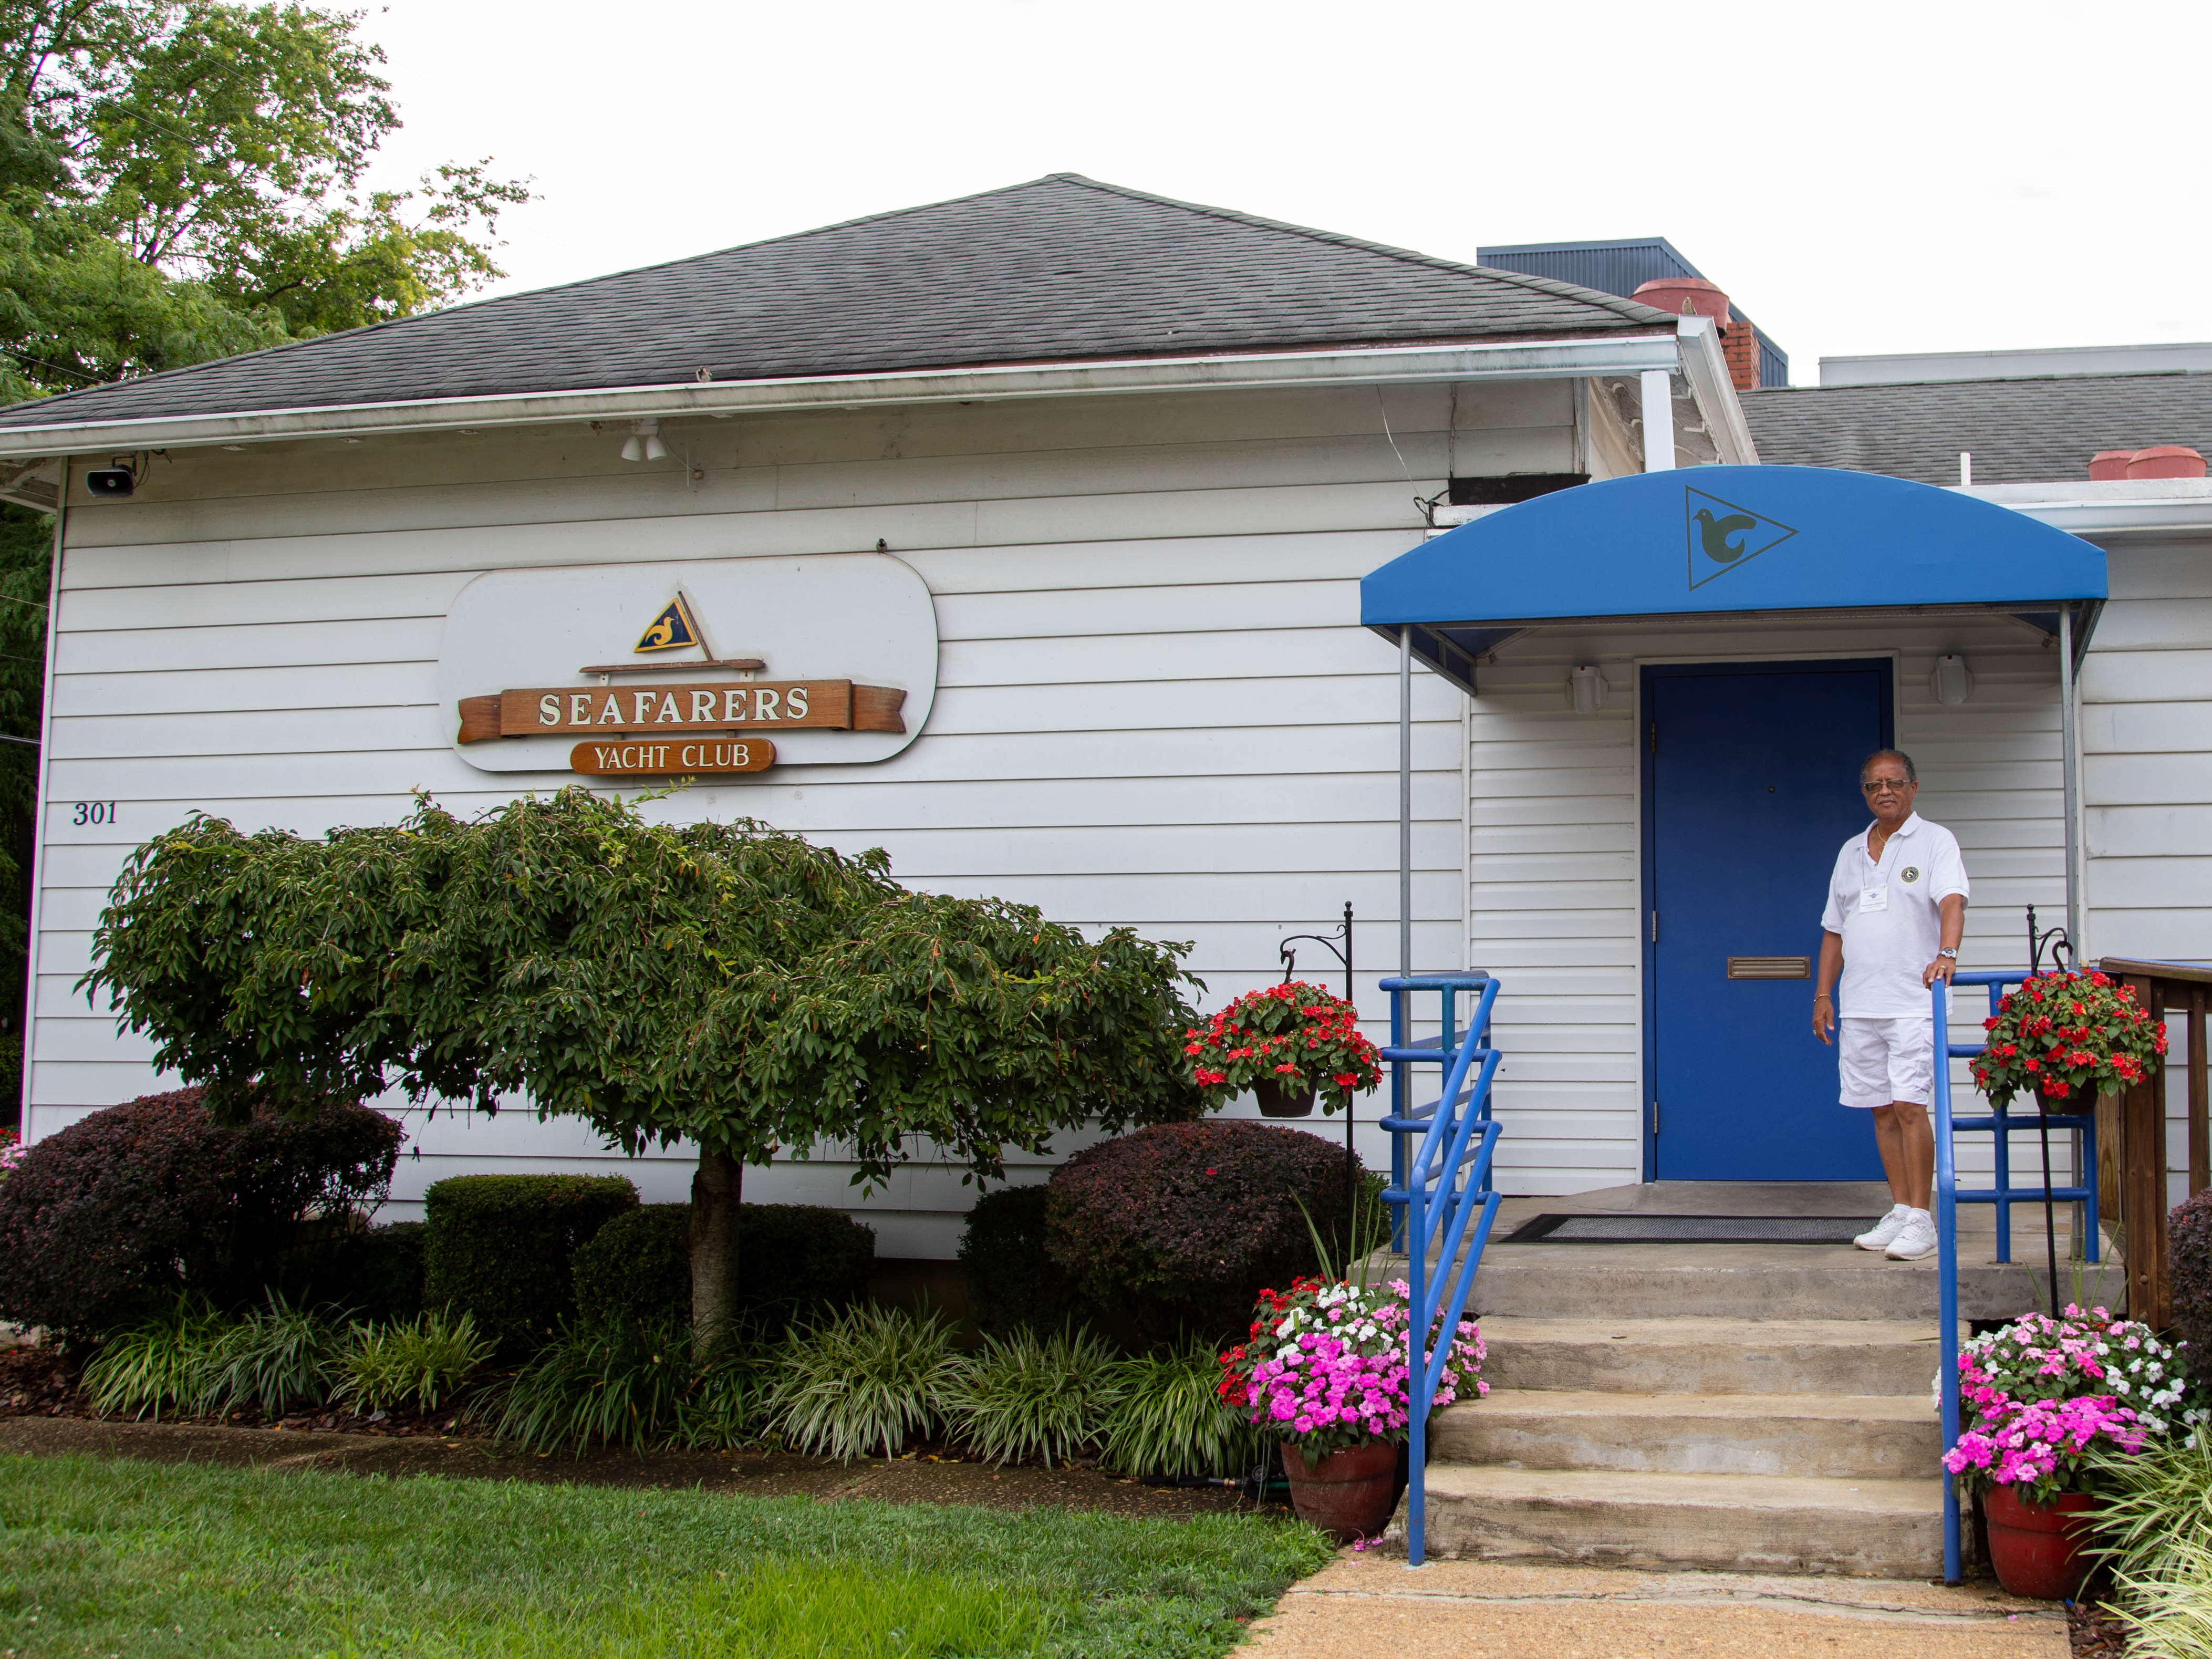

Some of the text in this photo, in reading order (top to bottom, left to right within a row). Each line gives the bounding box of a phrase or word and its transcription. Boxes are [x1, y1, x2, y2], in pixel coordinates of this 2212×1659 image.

[538, 687, 809, 726] SEAFARERS
[594, 744, 750, 769] YACHT CLUB
[73, 801, 116, 825] 301
